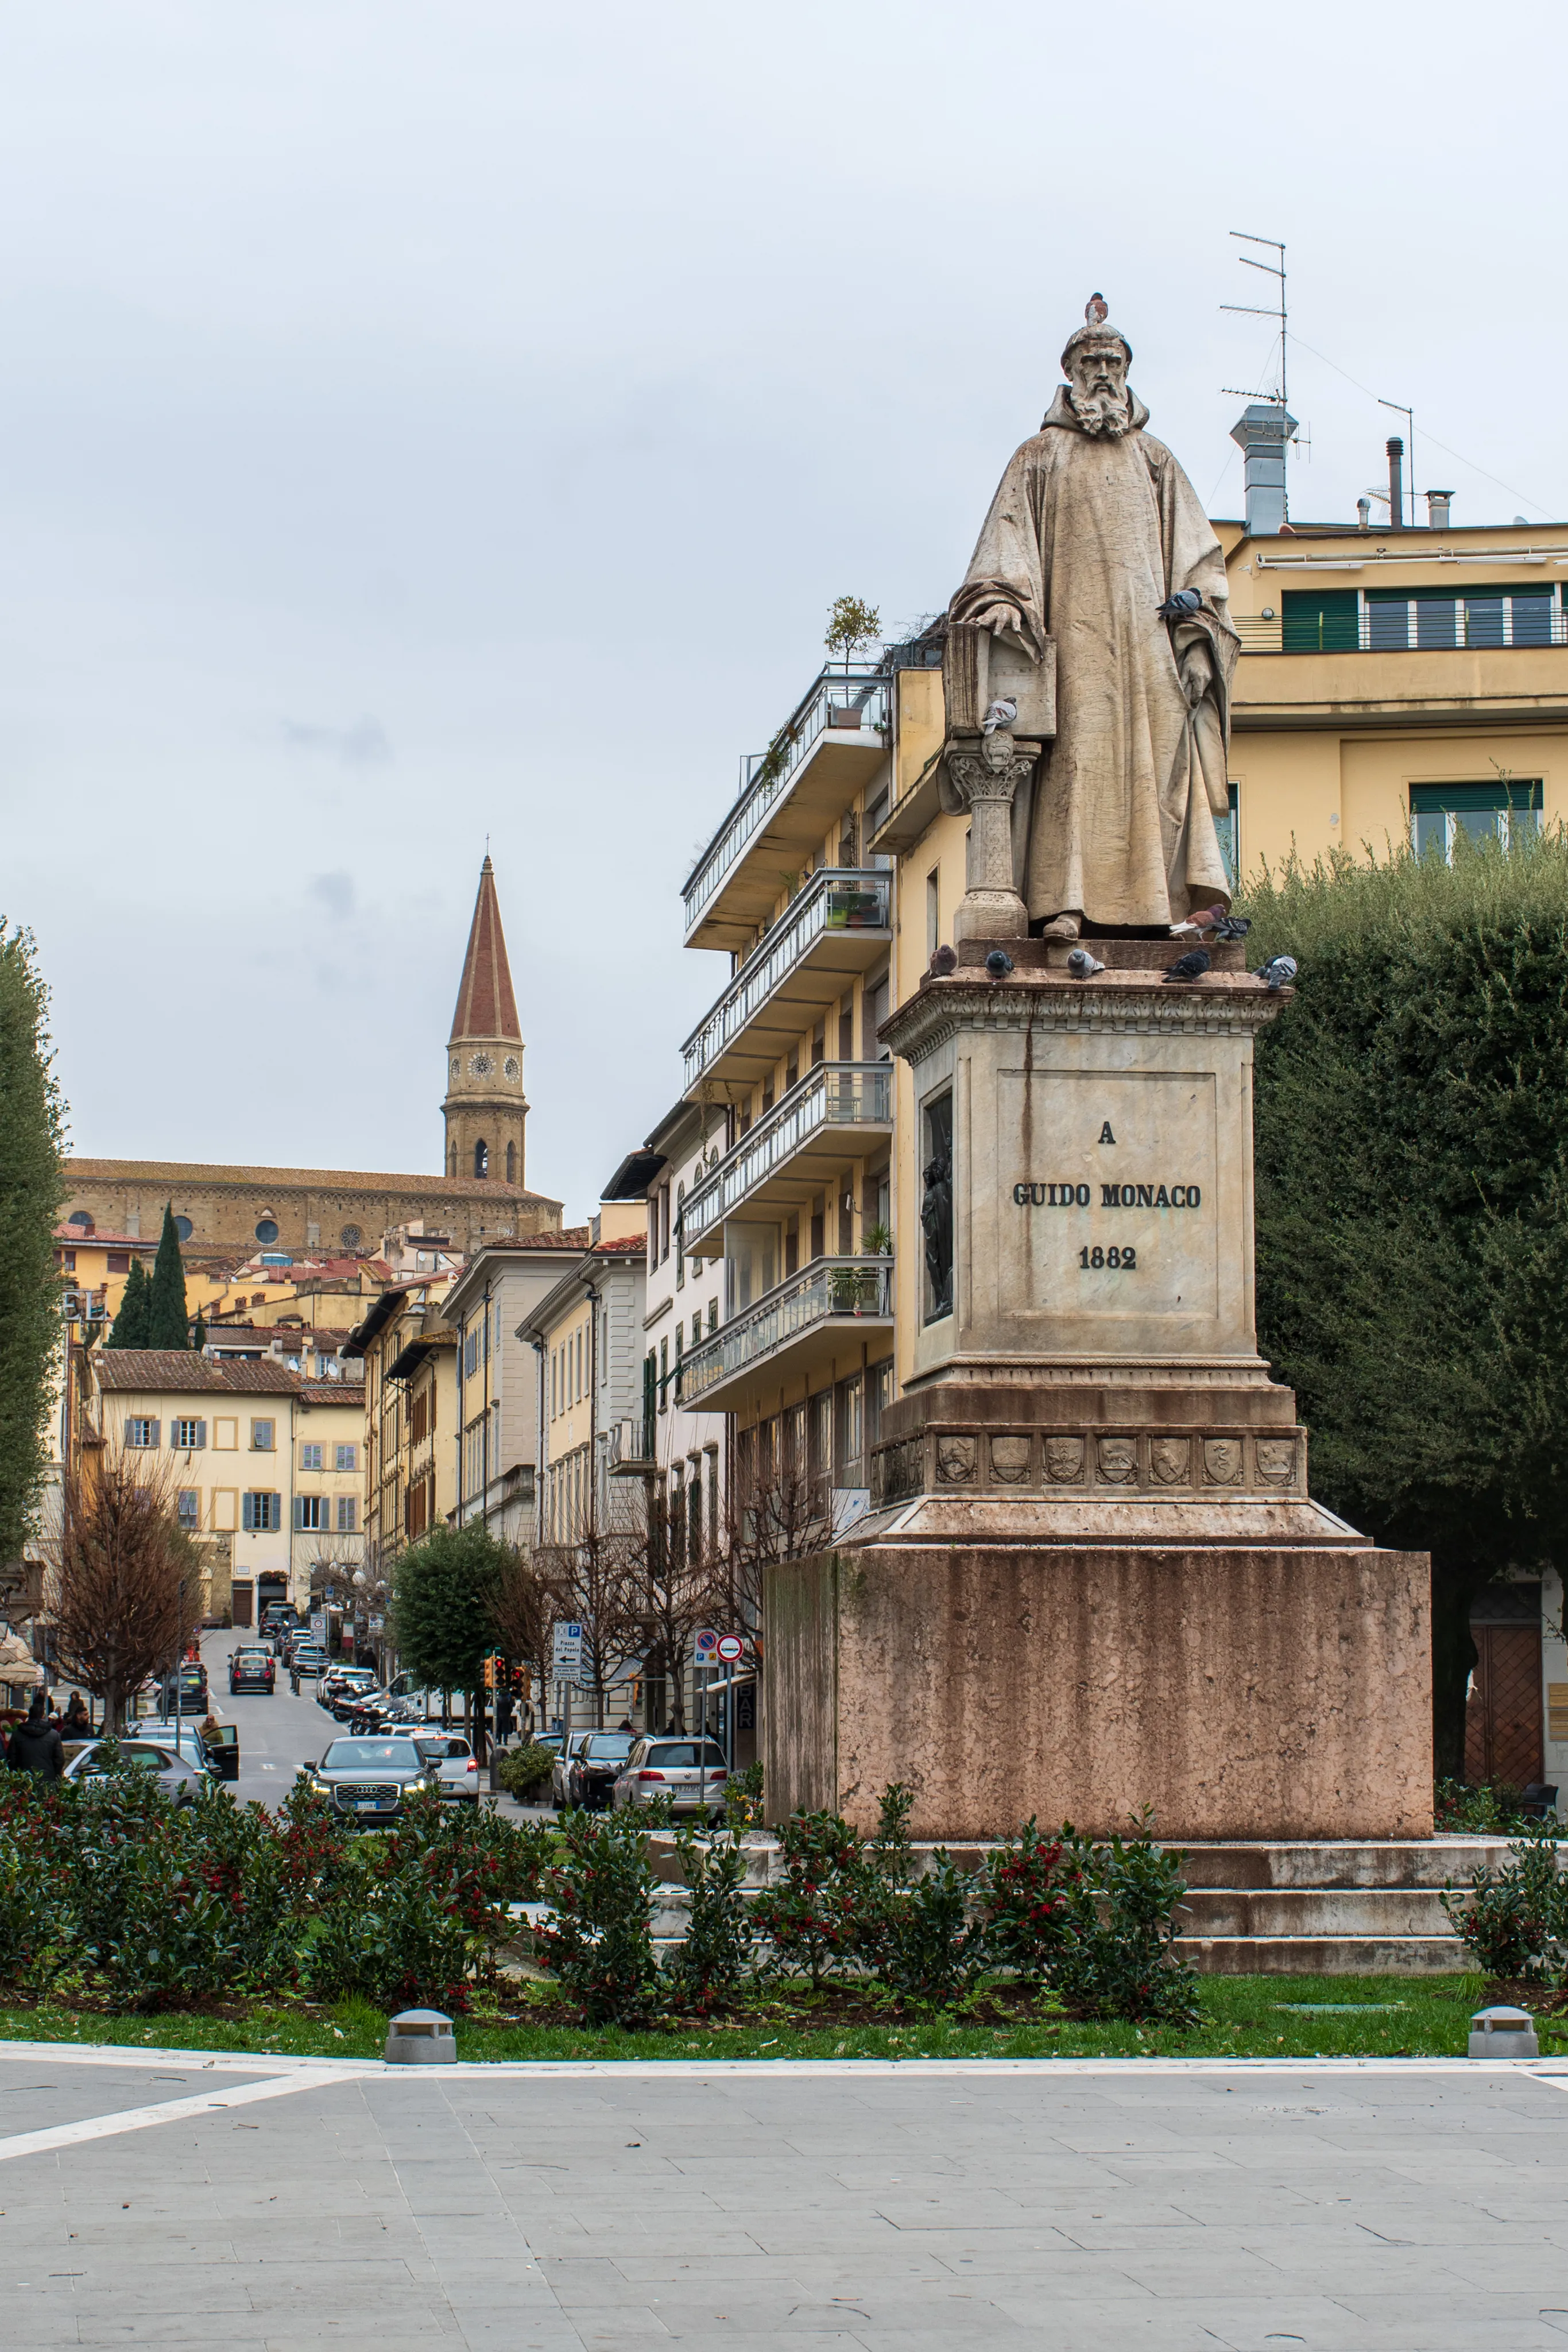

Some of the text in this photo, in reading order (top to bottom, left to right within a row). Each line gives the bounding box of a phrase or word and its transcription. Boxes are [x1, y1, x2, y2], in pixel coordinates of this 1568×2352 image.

[1097, 1121, 1116, 1144] A
[1013, 1182, 1201, 1208] GUIDO MONACO
[1079, 1246, 1136, 1270] 1882
[739, 1685, 752, 1727] BAR
